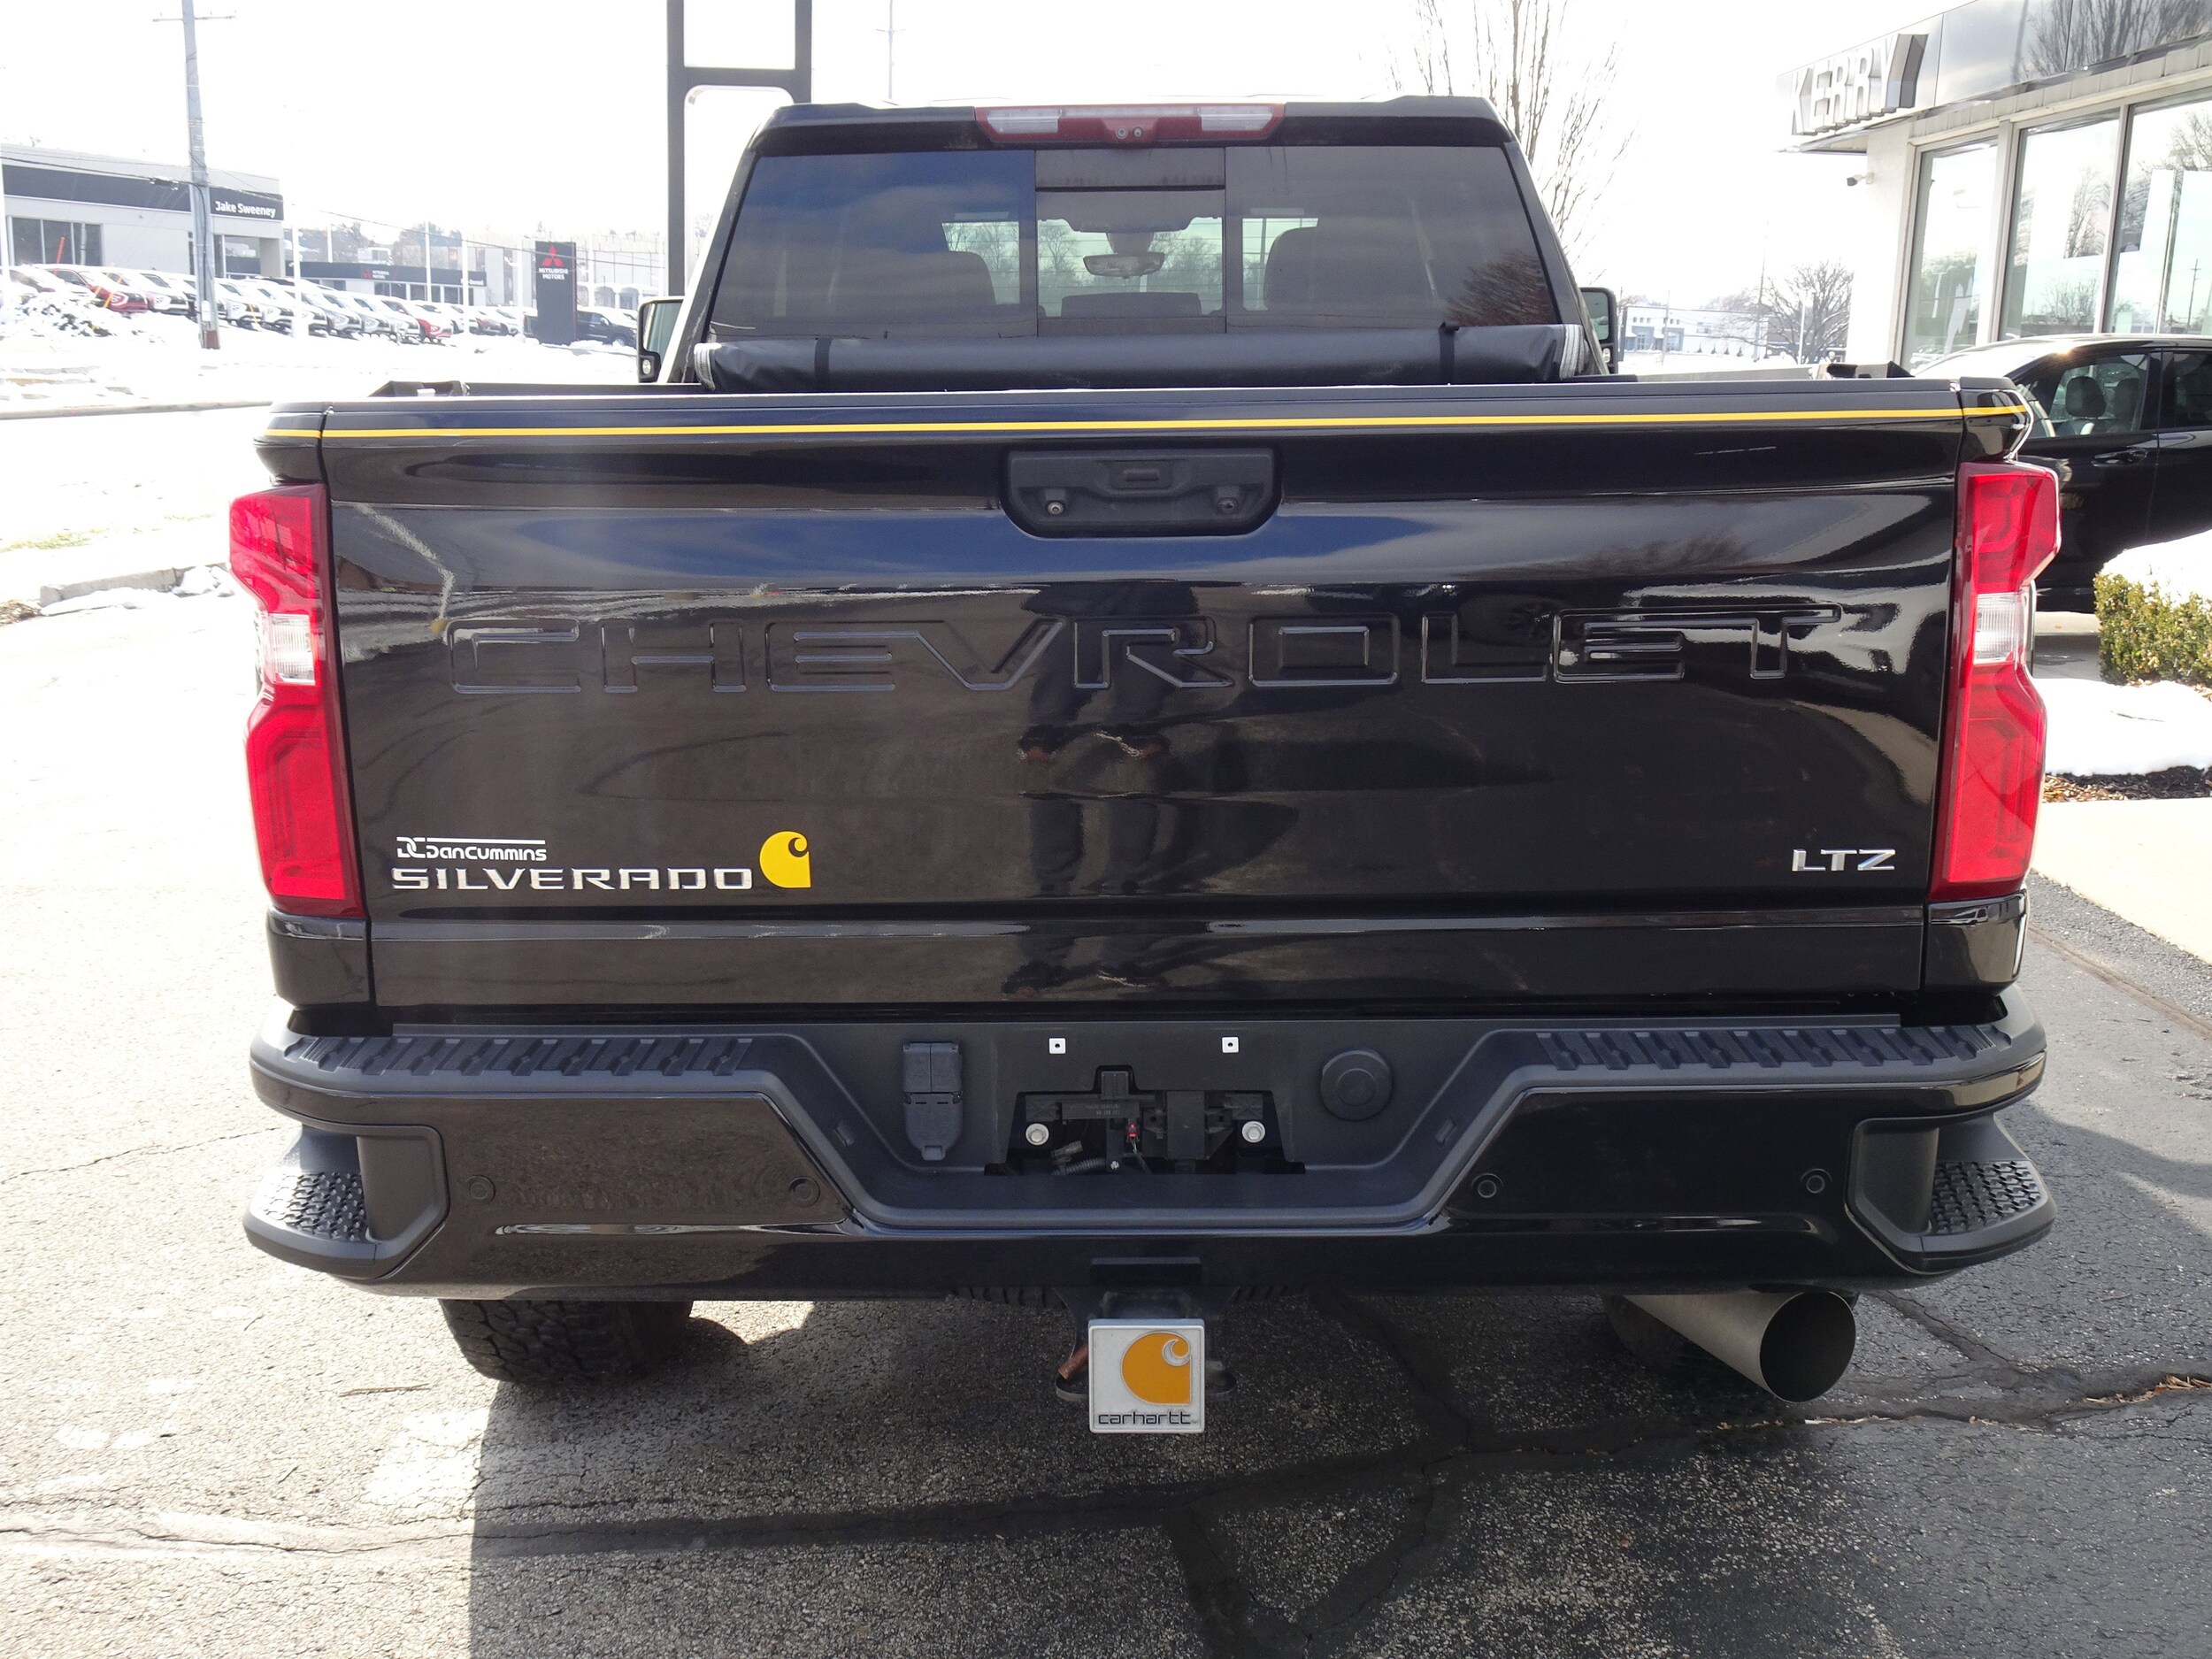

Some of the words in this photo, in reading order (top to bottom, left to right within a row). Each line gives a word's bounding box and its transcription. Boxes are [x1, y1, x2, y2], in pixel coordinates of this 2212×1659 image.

[1791, 34, 1918, 135] KERRY
[215, 200, 237, 212] Jake
[237, 203, 277, 219] Sweeney
[449, 603, 1843, 695] CHEVROLET
[1792, 849, 1896, 872] LTZ
[391, 867, 753, 890] SILVERADO
[1098, 1411, 1191, 1425] carhartt
